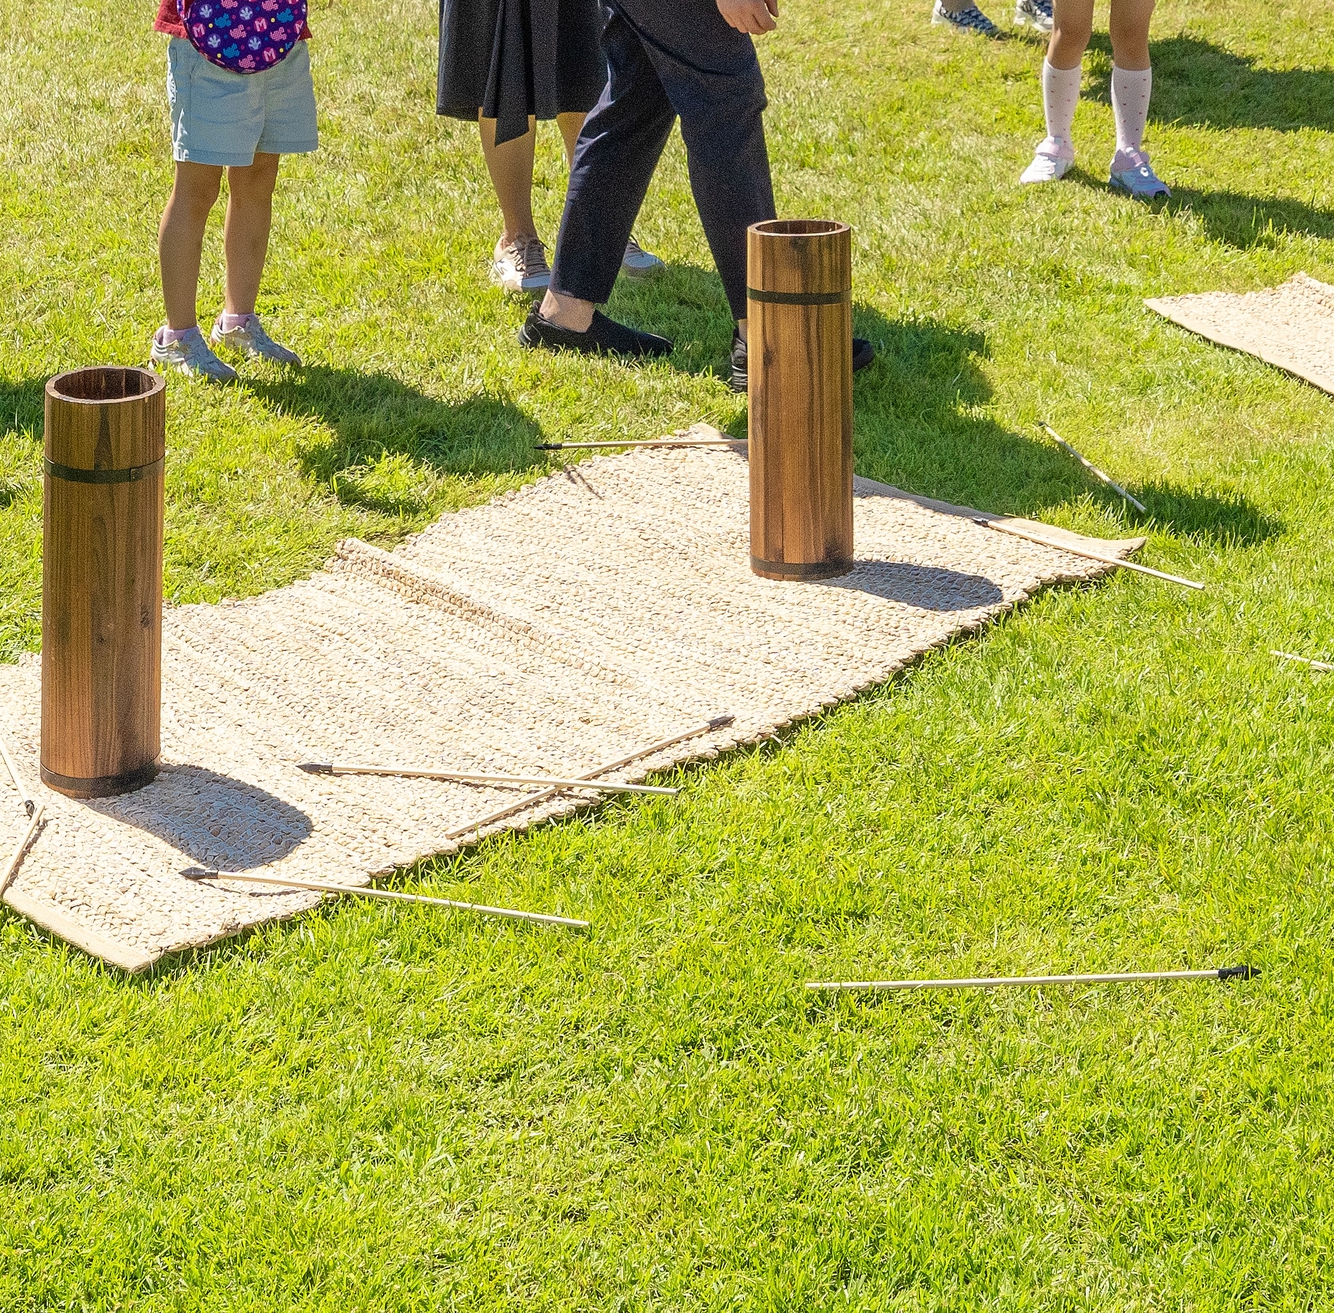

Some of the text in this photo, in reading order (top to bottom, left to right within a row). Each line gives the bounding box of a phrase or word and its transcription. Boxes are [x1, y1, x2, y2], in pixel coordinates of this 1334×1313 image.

[193, 23, 205, 38] M
[255, 18, 267, 32] M
[264, 48, 276, 62] M
